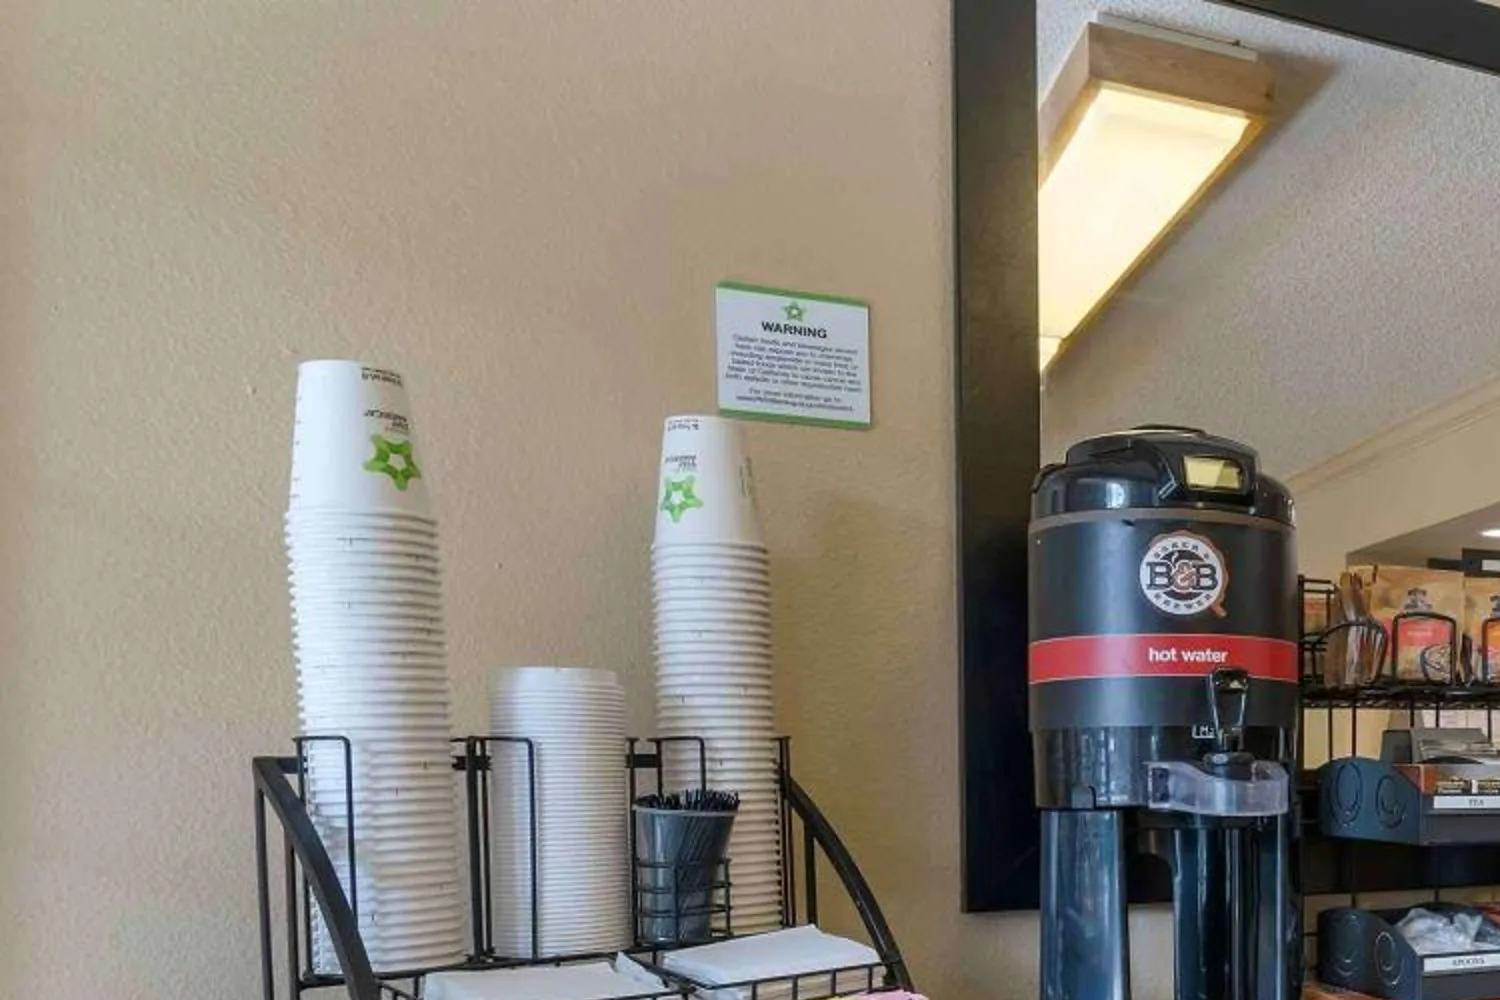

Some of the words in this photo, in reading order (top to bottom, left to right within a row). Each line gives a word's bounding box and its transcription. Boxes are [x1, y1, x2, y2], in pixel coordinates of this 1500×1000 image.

[761, 320, 828, 339] WARNING
[1148, 647, 1178, 662] hot
[1181, 647, 1229, 662] water
